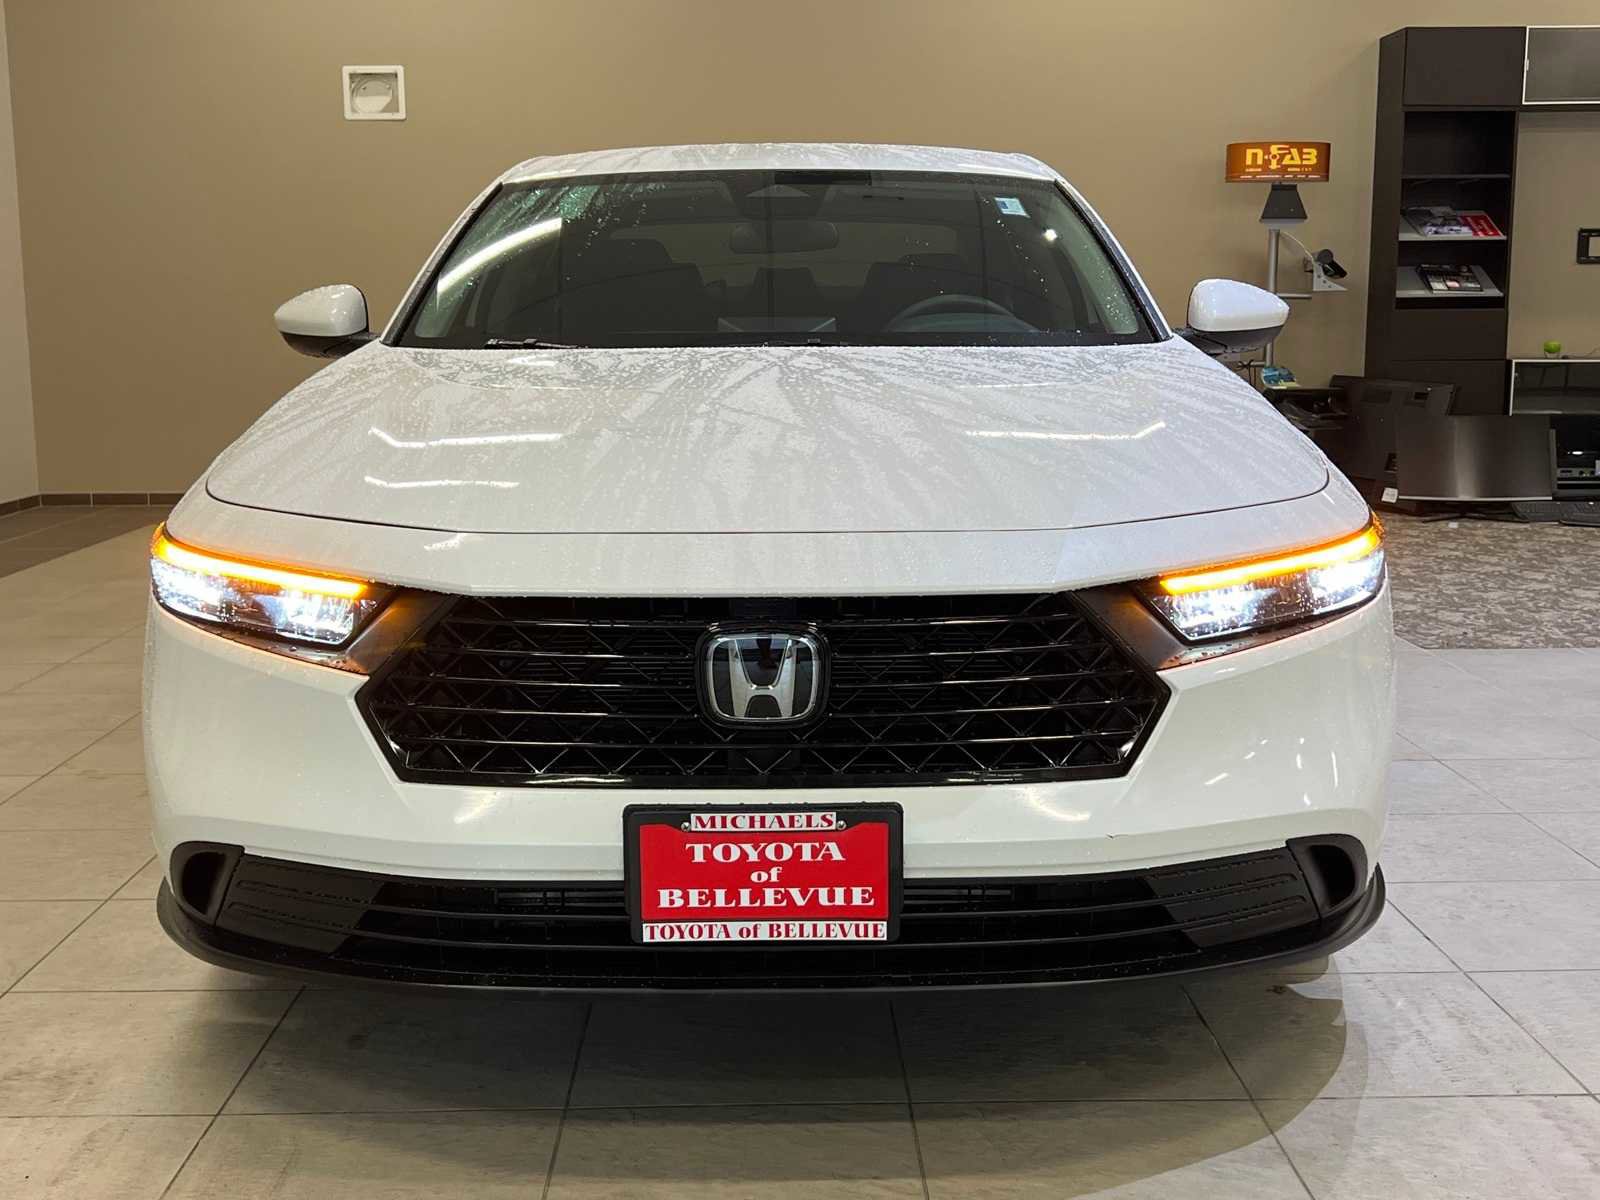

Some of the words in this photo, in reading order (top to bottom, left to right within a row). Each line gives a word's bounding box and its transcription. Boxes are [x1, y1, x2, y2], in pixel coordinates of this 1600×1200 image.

[693, 813, 833, 829] MICHAELS
[685, 841, 846, 863] TOYOTA
[750, 867, 783, 883] of
[657, 886, 875, 909] BELLEVUE
[645, 923, 731, 940] TOYOTA
[738, 923, 762, 939] of
[768, 922, 886, 939] BELLEVUE
